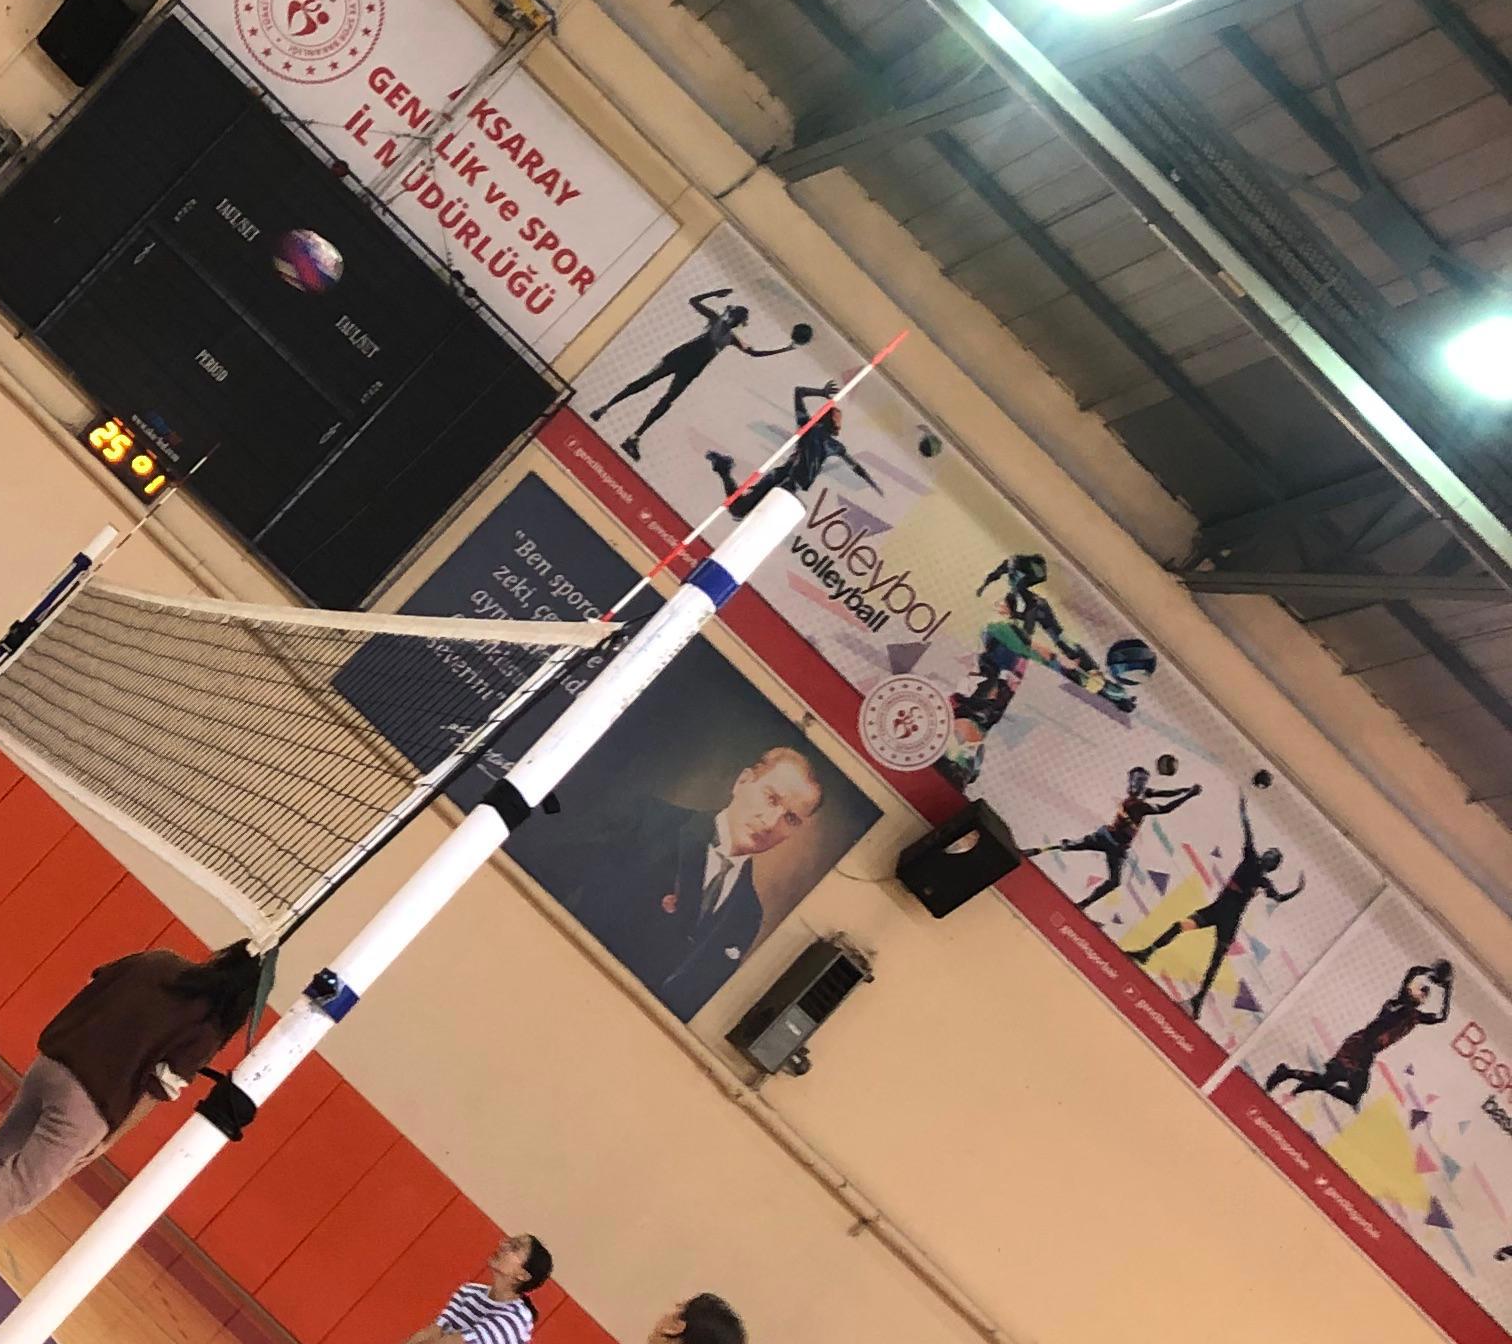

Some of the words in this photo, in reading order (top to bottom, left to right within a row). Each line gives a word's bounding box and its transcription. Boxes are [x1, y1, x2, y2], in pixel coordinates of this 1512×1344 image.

[344, 104, 374, 146] İL
[368, 66, 489, 187] GENLİK
[485, 182, 519, 221] ve
[519, 217, 595, 296] SPOR
[195, 349, 229, 383] PERIOD
[492, 565, 537, 608] zeki,
[789, 534, 892, 637] volleyball
[803, 487, 953, 643] Voleybol
